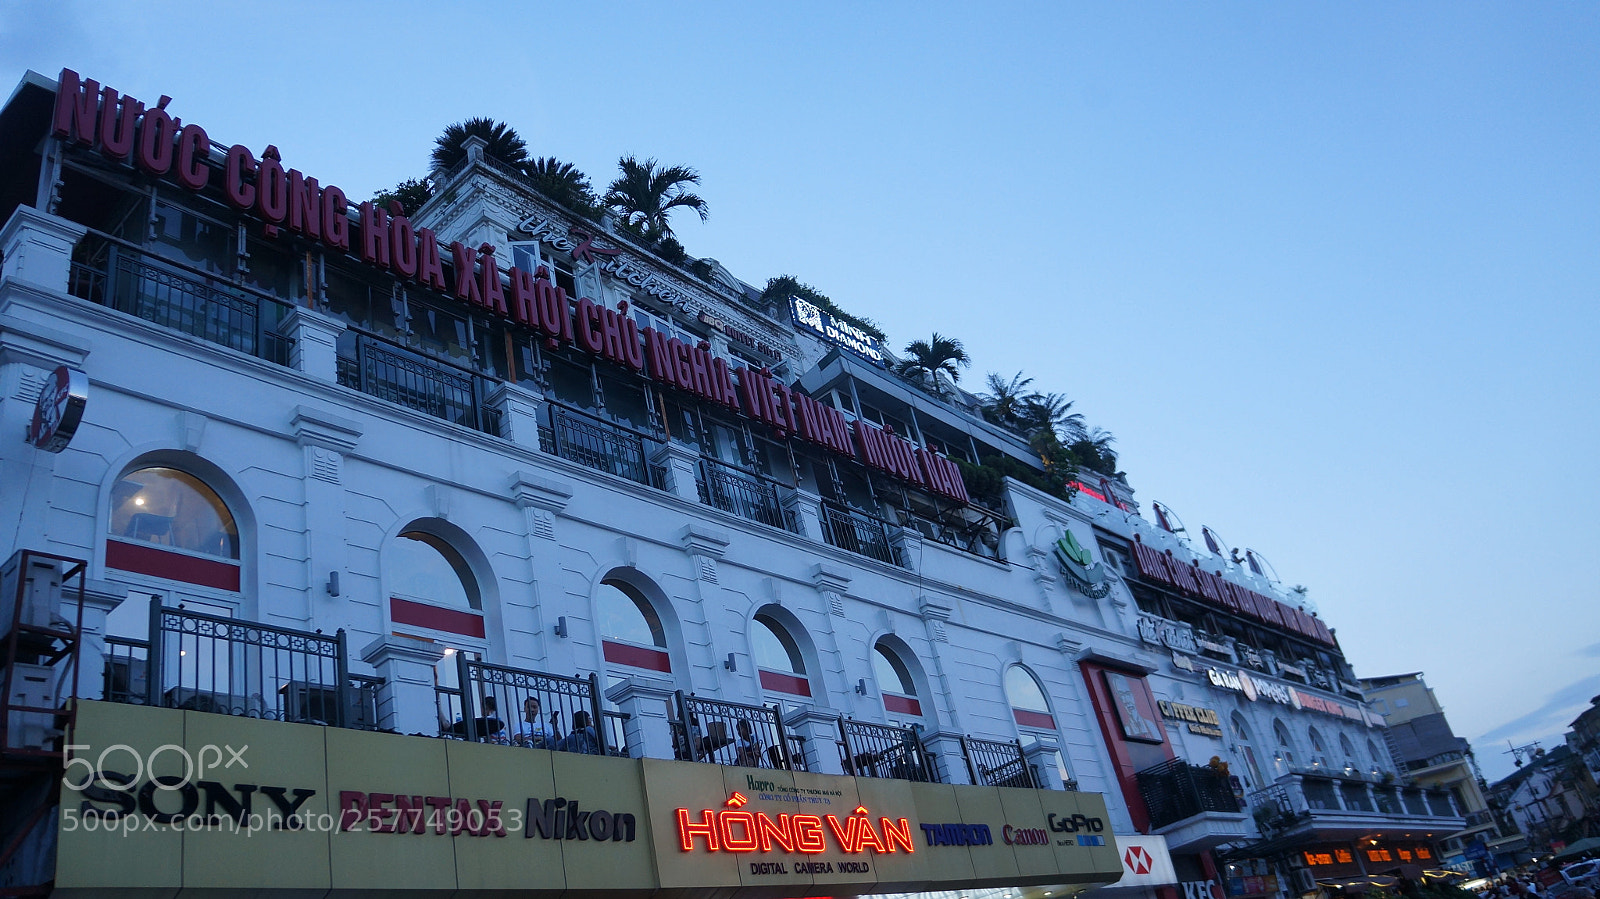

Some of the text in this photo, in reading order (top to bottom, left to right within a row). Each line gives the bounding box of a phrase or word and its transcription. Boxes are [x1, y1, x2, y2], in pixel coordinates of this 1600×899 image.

[516, 214, 572, 252] the
[52, 67, 969, 506] NƯỚC CỘNG HÒA XÃ HỘI CHỦ NGHĨA VIỆT NAM MUÔN NĂM
[701, 312, 725, 333] BBQ
[826, 325, 881, 361] DIAMOND
[80, 770, 316, 831] SONY
[746, 774, 775, 792] Hapro
[339, 790, 507, 838] PENTAX
[525, 797, 637, 842] Nikon
[675, 791, 915, 853] HỒNG VÂN
[1048, 813, 1104, 833] GoPro
[920, 823, 993, 847] TAMRON
[1002, 824, 1050, 846] Canon
[751, 860, 870, 875] DIGITAL CAMERA WORLD
